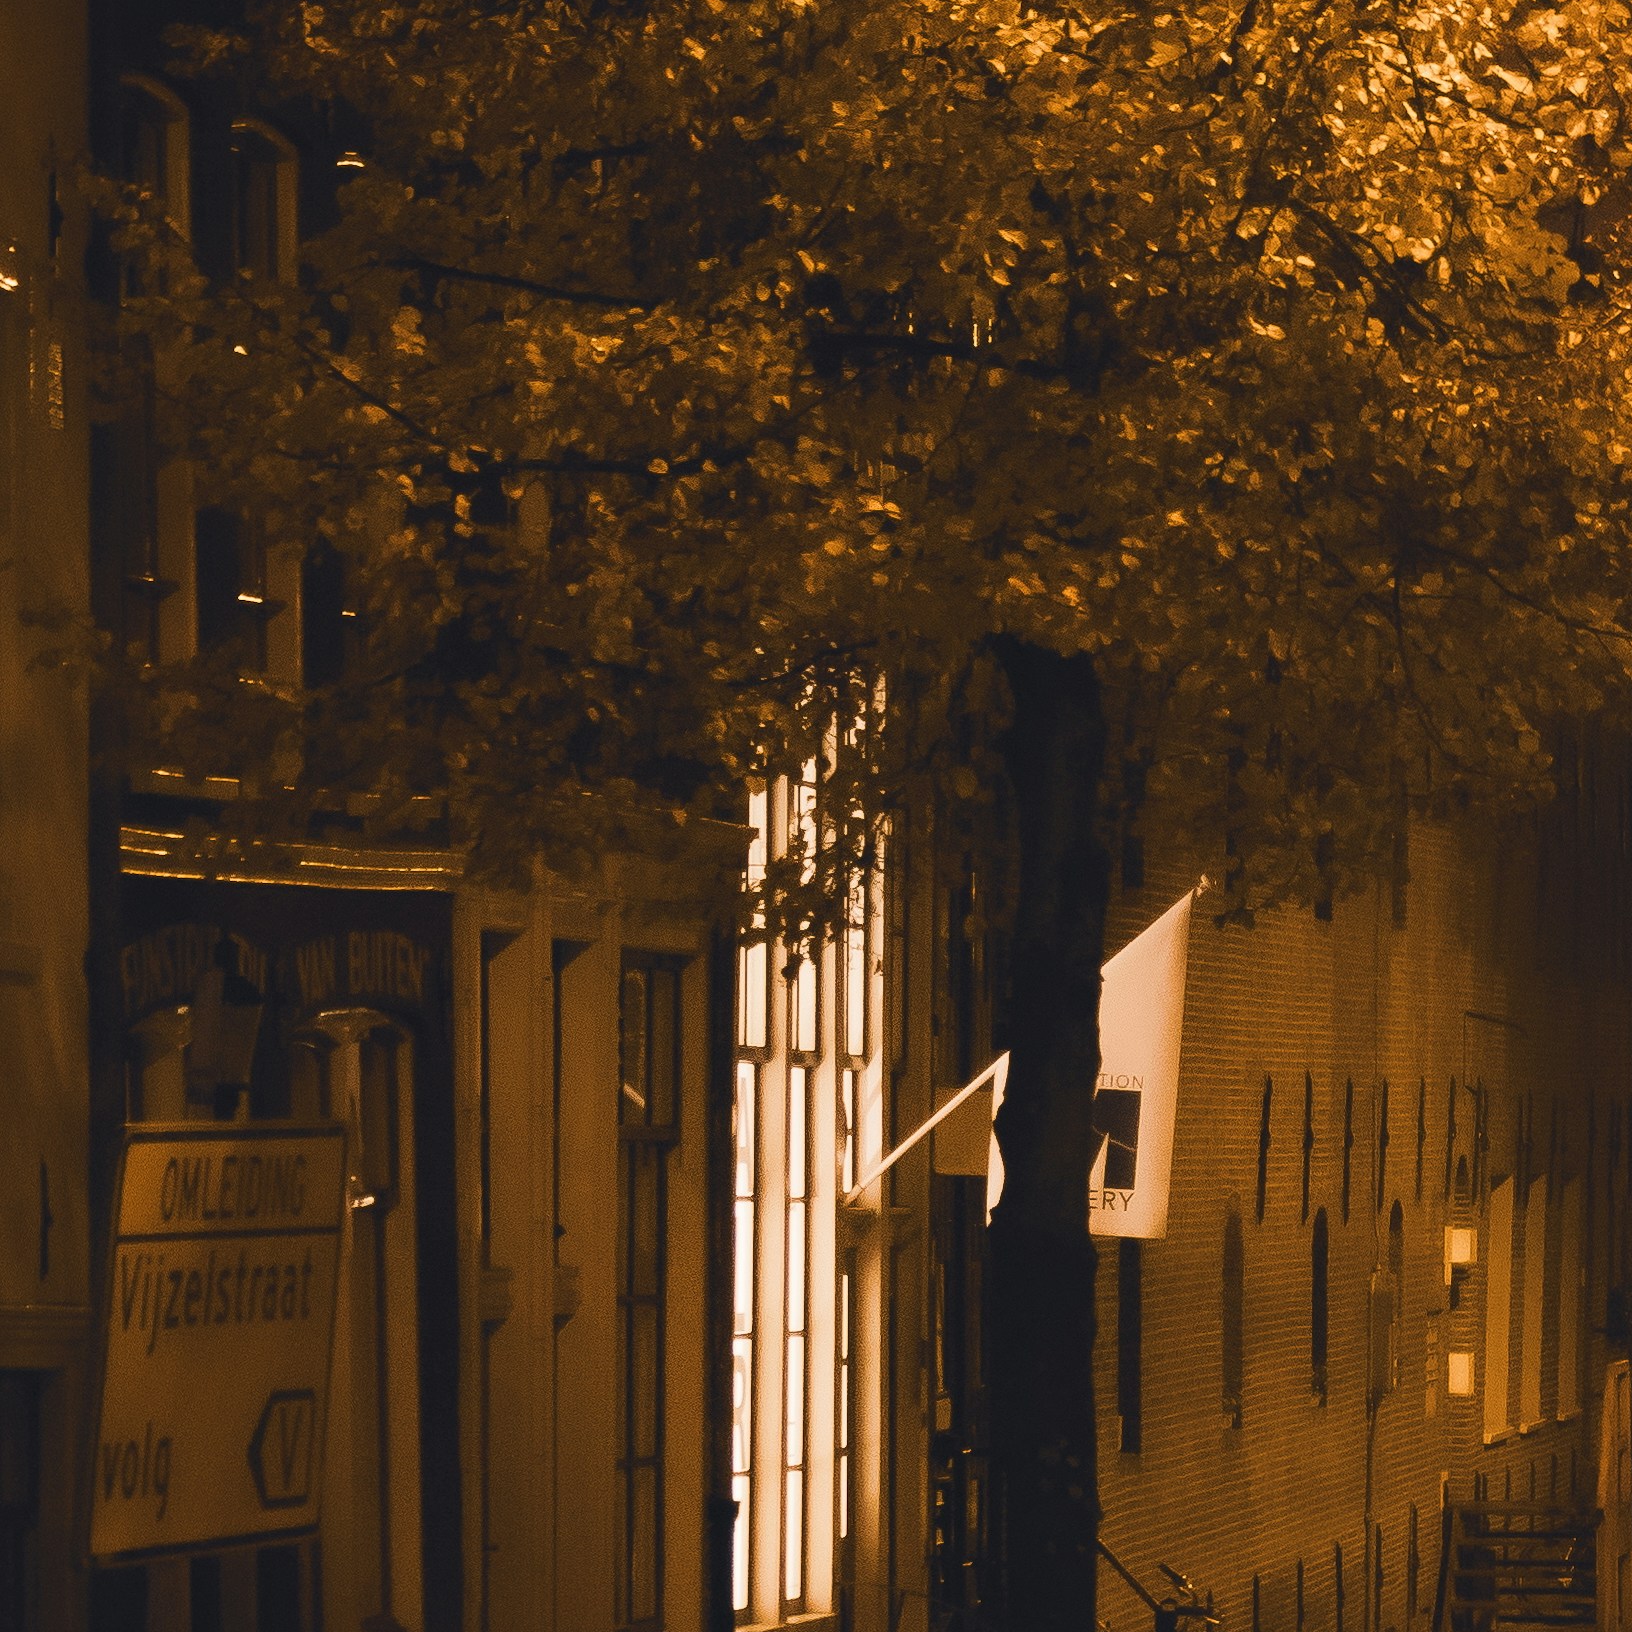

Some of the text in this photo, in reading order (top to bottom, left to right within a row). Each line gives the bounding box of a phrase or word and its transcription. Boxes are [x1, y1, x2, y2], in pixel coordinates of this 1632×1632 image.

[161, 1153, 308, 1221] OMLEIDING
[120, 1247, 313, 1356] Vijzelstraat
[102, 1421, 173, 1521] volg
